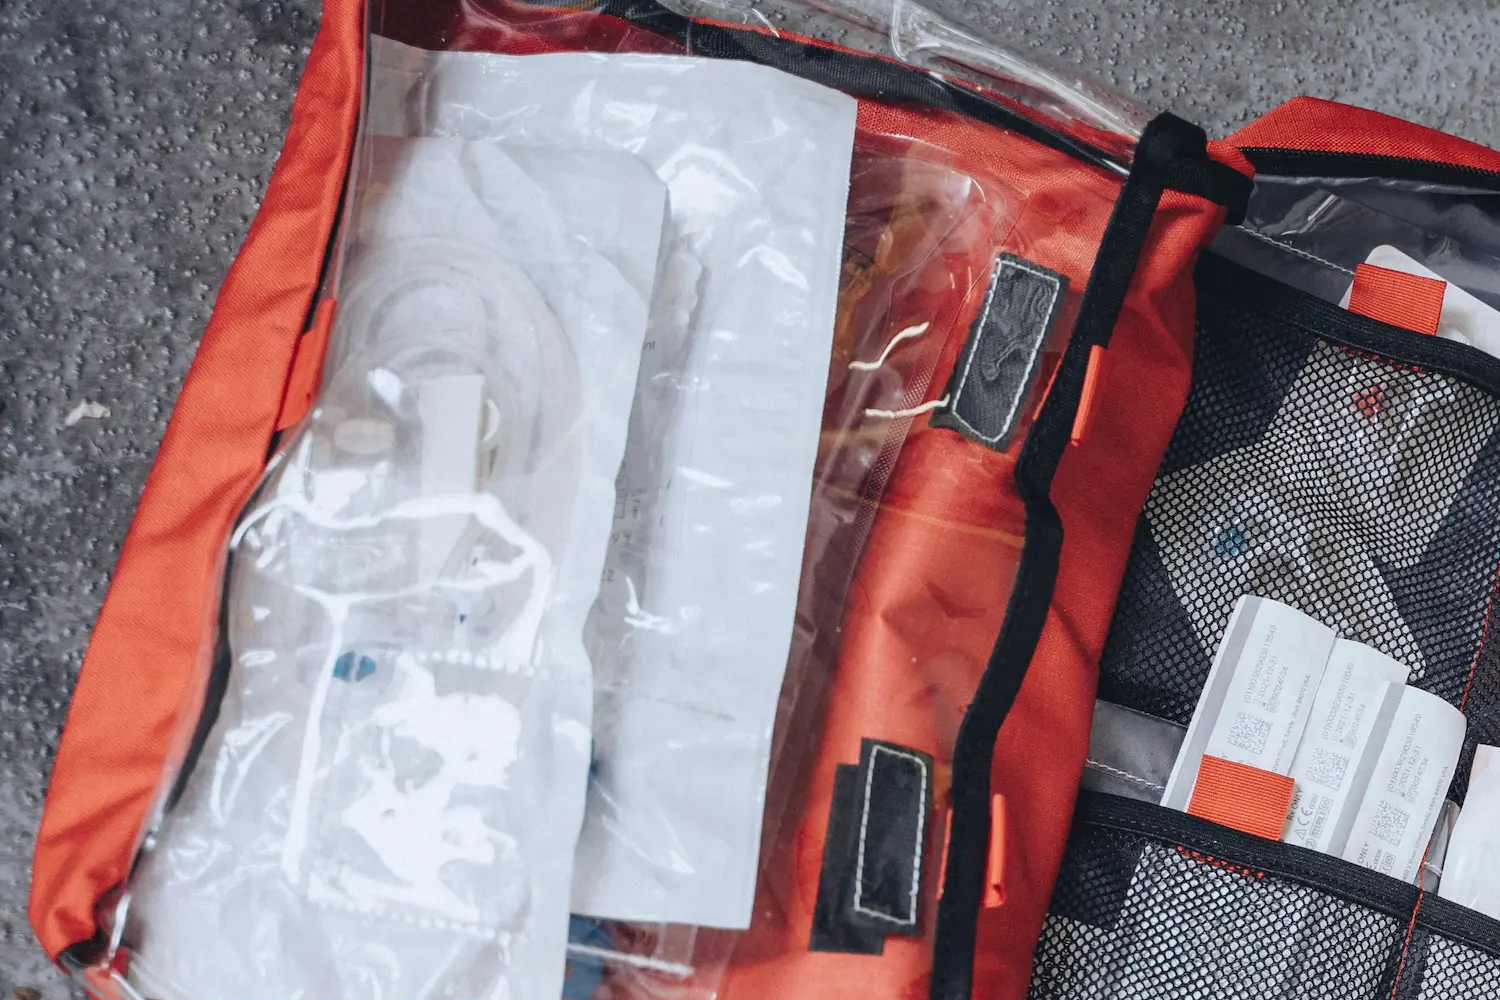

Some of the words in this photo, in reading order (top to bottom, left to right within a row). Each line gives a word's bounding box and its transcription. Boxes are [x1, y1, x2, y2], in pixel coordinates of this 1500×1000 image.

[1290, 787, 1304, 810] ONLY
[1310, 809, 1327, 836] STERILE
[1356, 840, 1371, 864] ONLY
